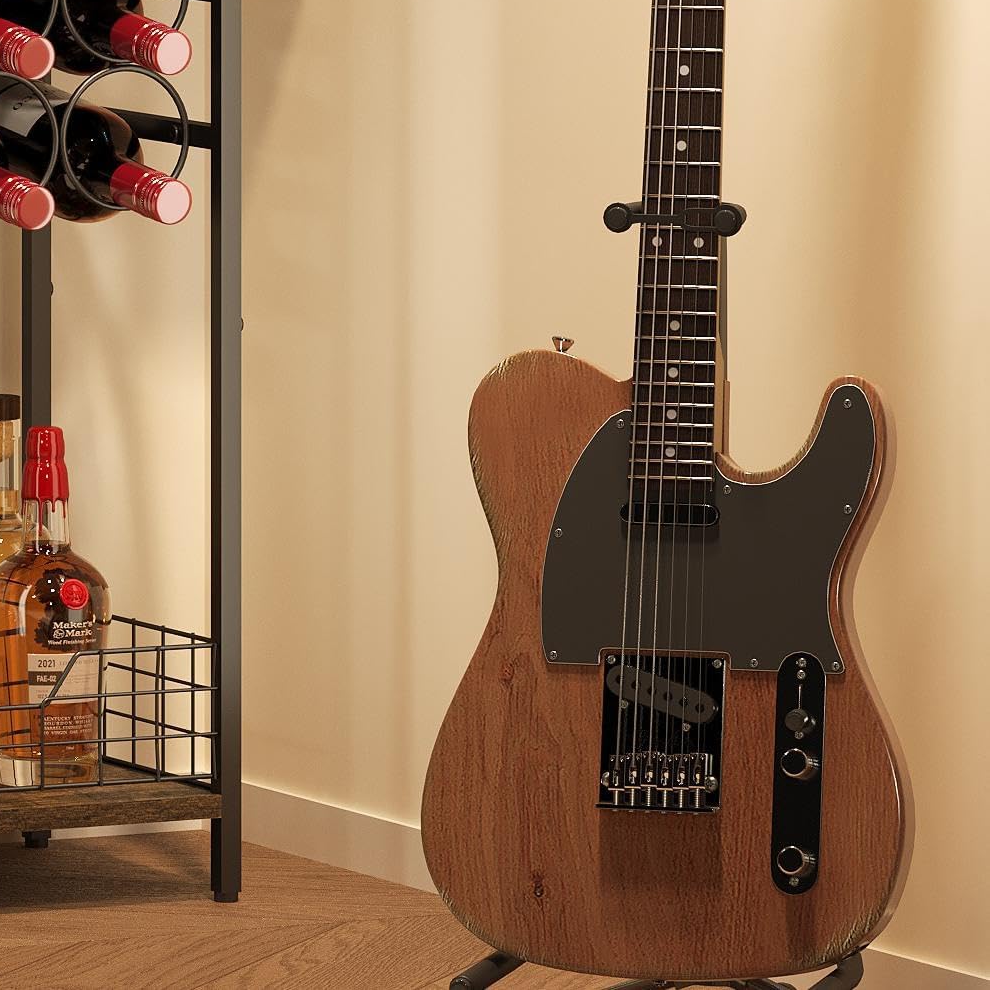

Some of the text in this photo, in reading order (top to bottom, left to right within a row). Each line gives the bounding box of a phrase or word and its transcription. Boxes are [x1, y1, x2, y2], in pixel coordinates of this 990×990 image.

[52, 621, 93, 630] Maker's
[65, 629, 92, 638] Mark
[37, 660, 56, 668] 2021
[36, 675, 57, 683] FAE-02
